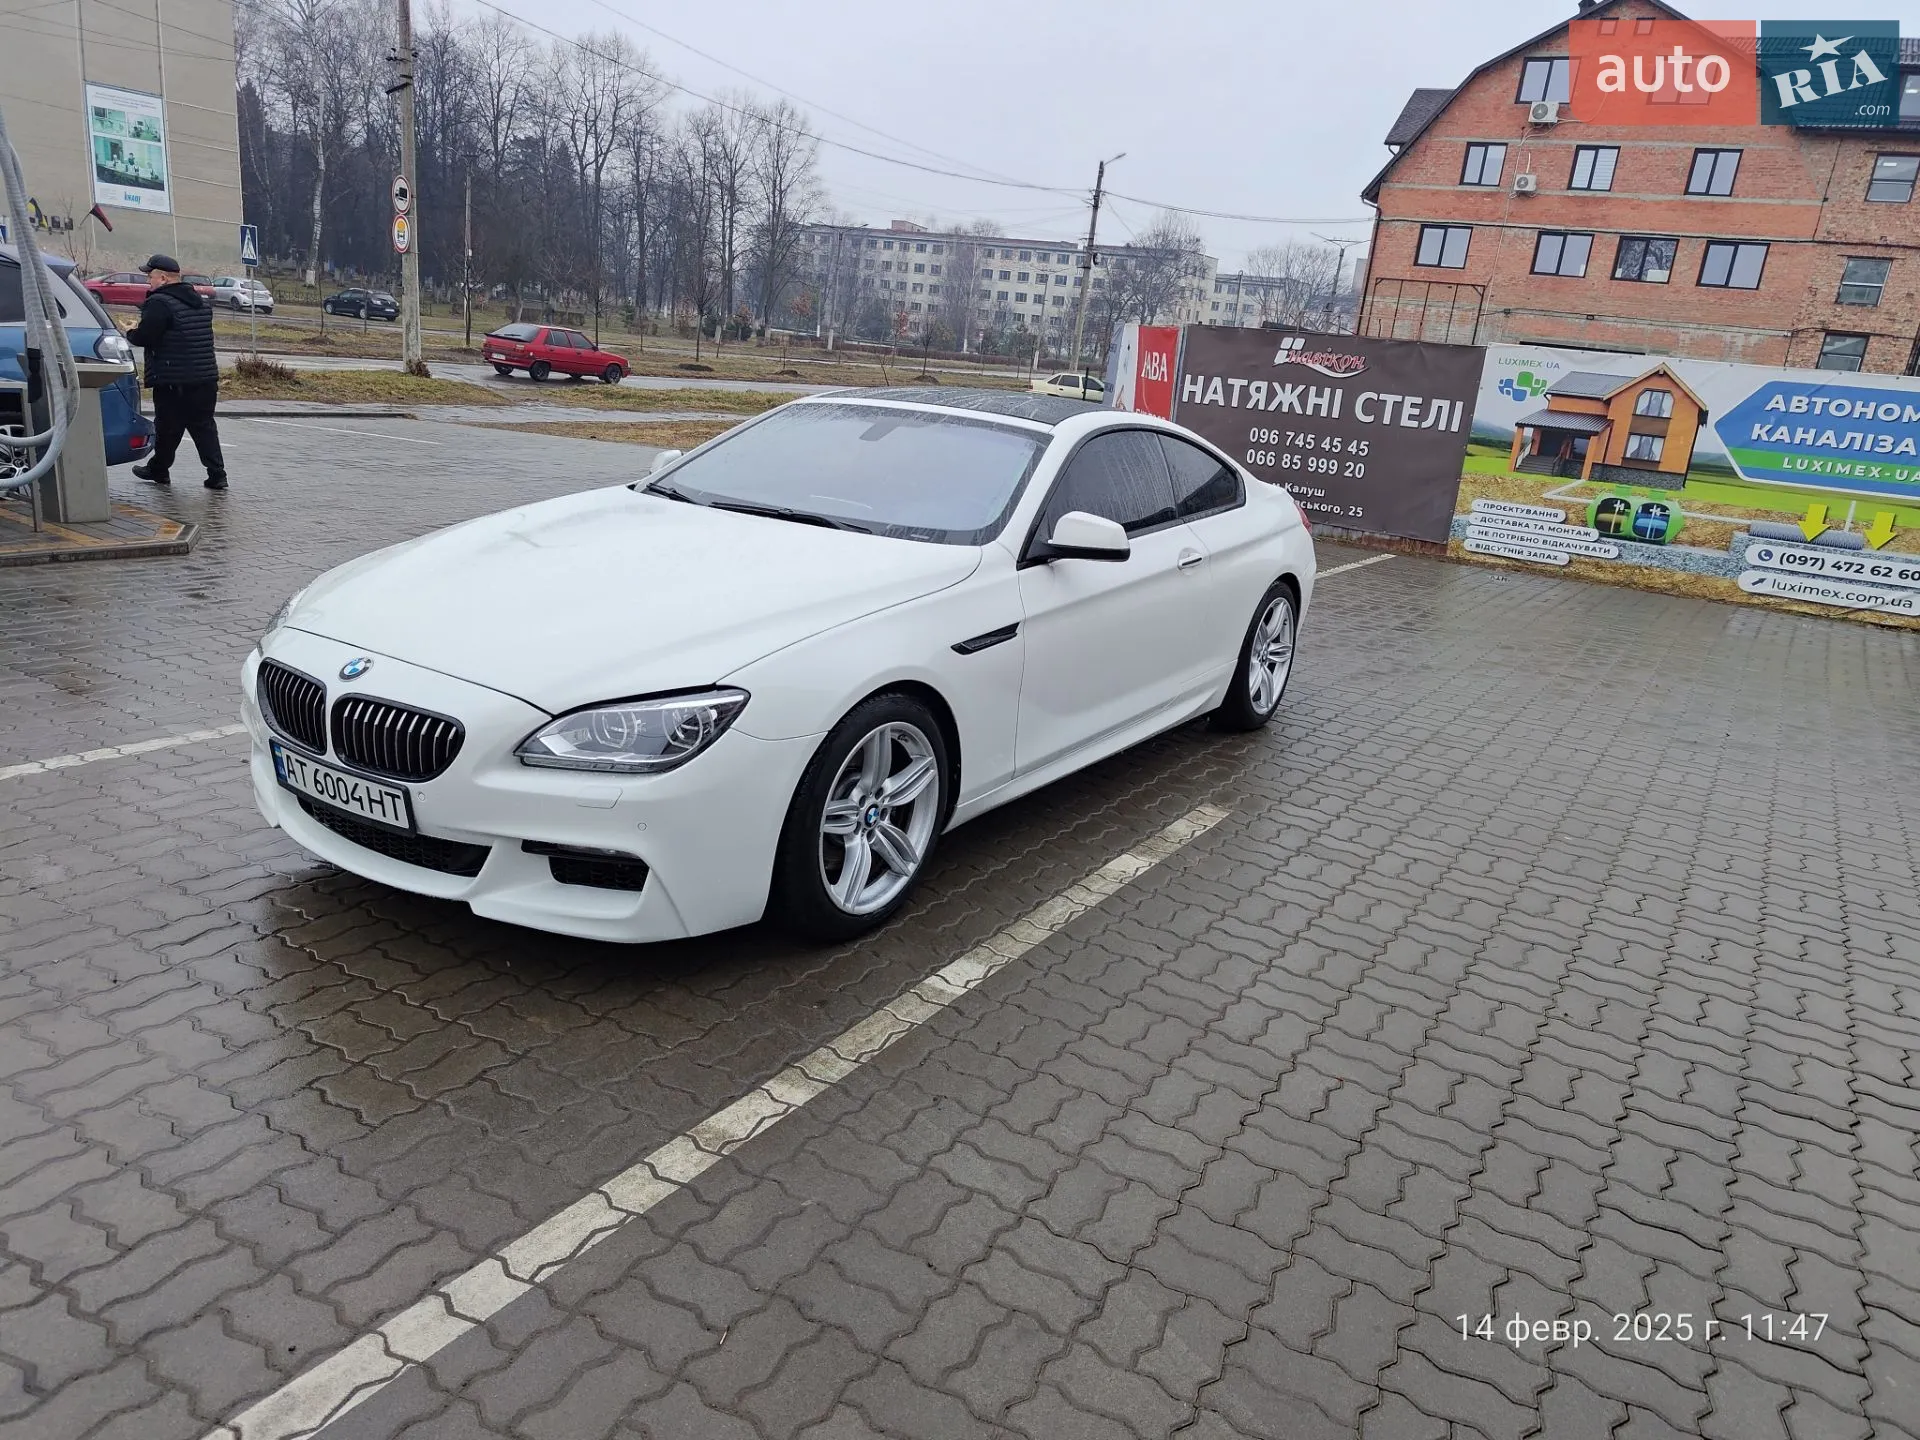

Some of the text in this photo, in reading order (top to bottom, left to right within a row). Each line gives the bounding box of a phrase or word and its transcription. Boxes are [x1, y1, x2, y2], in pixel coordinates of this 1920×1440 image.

[1181, 374, 1464, 433] НАТЯЖНІ СТЕЛІ
[1764, 394, 1920, 423] АВТОНОМ
[1249, 427, 1370, 456] 096 745 45 45
[1751, 423, 1918, 457] КАНАЛІЗА
[1246, 448, 1365, 478] 066 85 999 20
[1284, 482, 1326, 497] Калуш
[1348, 506, 1363, 517] 25
[1483, 502, 1559, 519] ПРОЄКТУВАННЯ
[1479, 516, 1592, 538] ДОСТАВКА ТА МОНТАЖ
[1475, 542, 1559, 561] ВІДСУТНІЙ ЗАПАХ
[1477, 529, 1611, 555] НЕ ПОТРІБНО ВІДКАЧУВАТИ
[1779, 552, 1825, 571] (097)
[1831, 560, 1865, 575] 472
[1869, 565, 1893, 578] 62
[1771, 578, 1913, 609] luximex.com.ua
[285, 754, 401, 821] AT 6004HT
